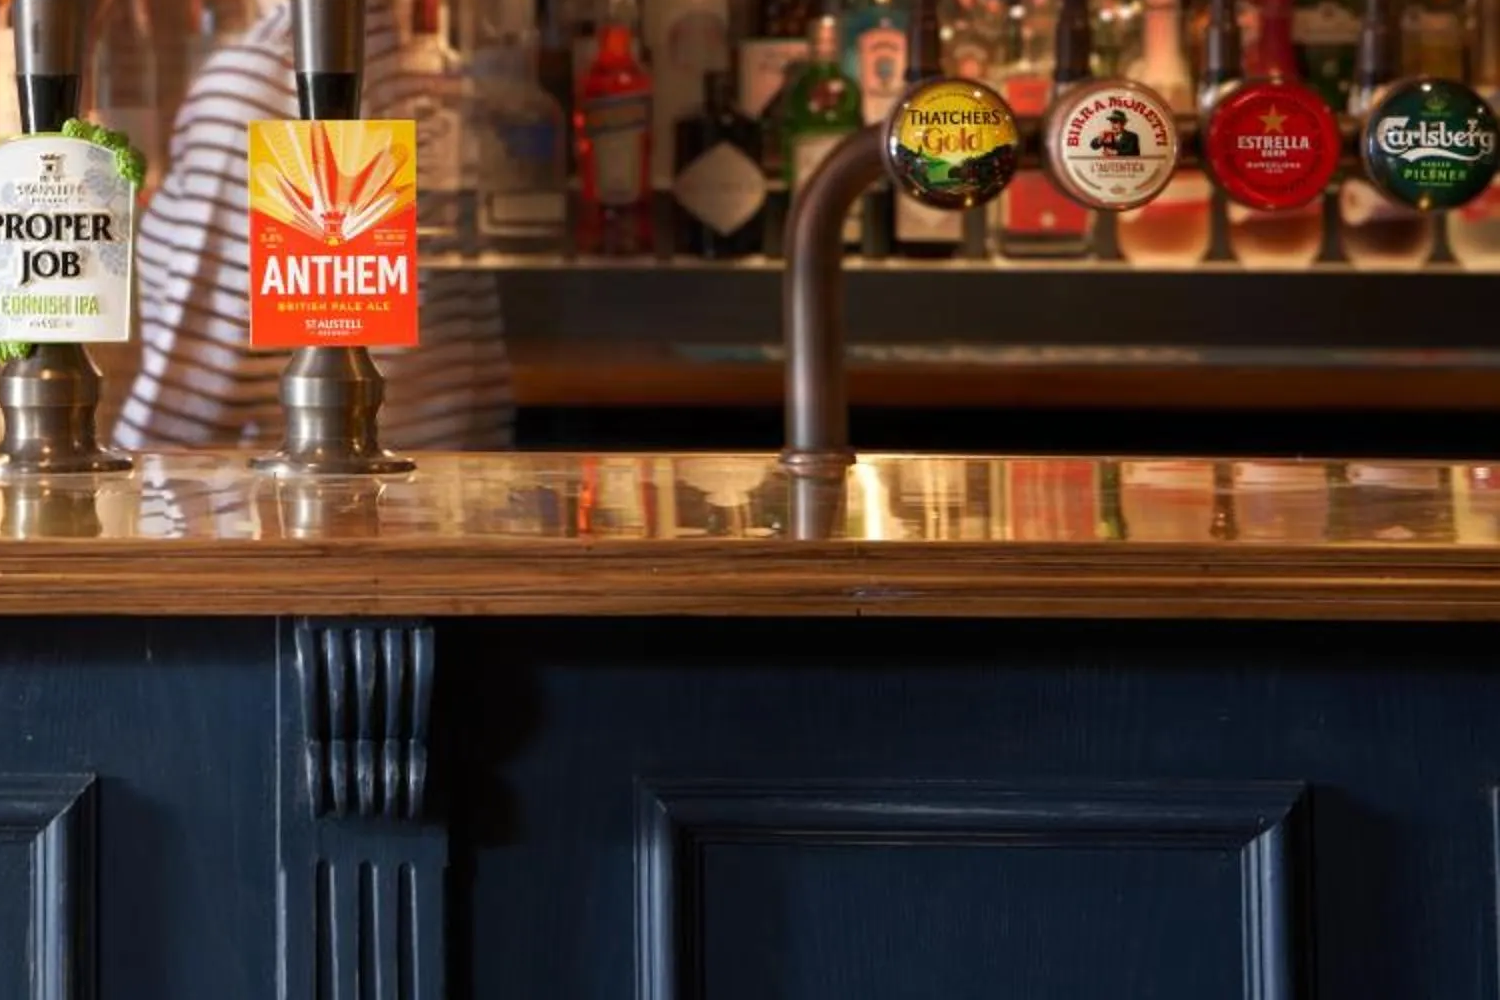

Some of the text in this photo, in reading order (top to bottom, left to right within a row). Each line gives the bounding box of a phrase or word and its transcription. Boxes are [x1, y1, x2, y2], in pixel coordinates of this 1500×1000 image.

[909, 109, 1001, 126] THATCHERS
[1067, 96, 1168, 148] BIRRA MORETTI
[922, 127, 983, 157] Gold
[1237, 135, 1311, 150] ESTRELLA
[1377, 116, 1495, 162] Carlsberg
[1403, 168, 1467, 180] PILSNER
[21, 250, 82, 286] JOB
[260, 254, 409, 296] ANTHEM
[1, 295, 100, 316] CORNISH IPA
[277, 303, 390, 312] BRITISH PALE ALE
[317, 319, 363, 330] AUSTELL
